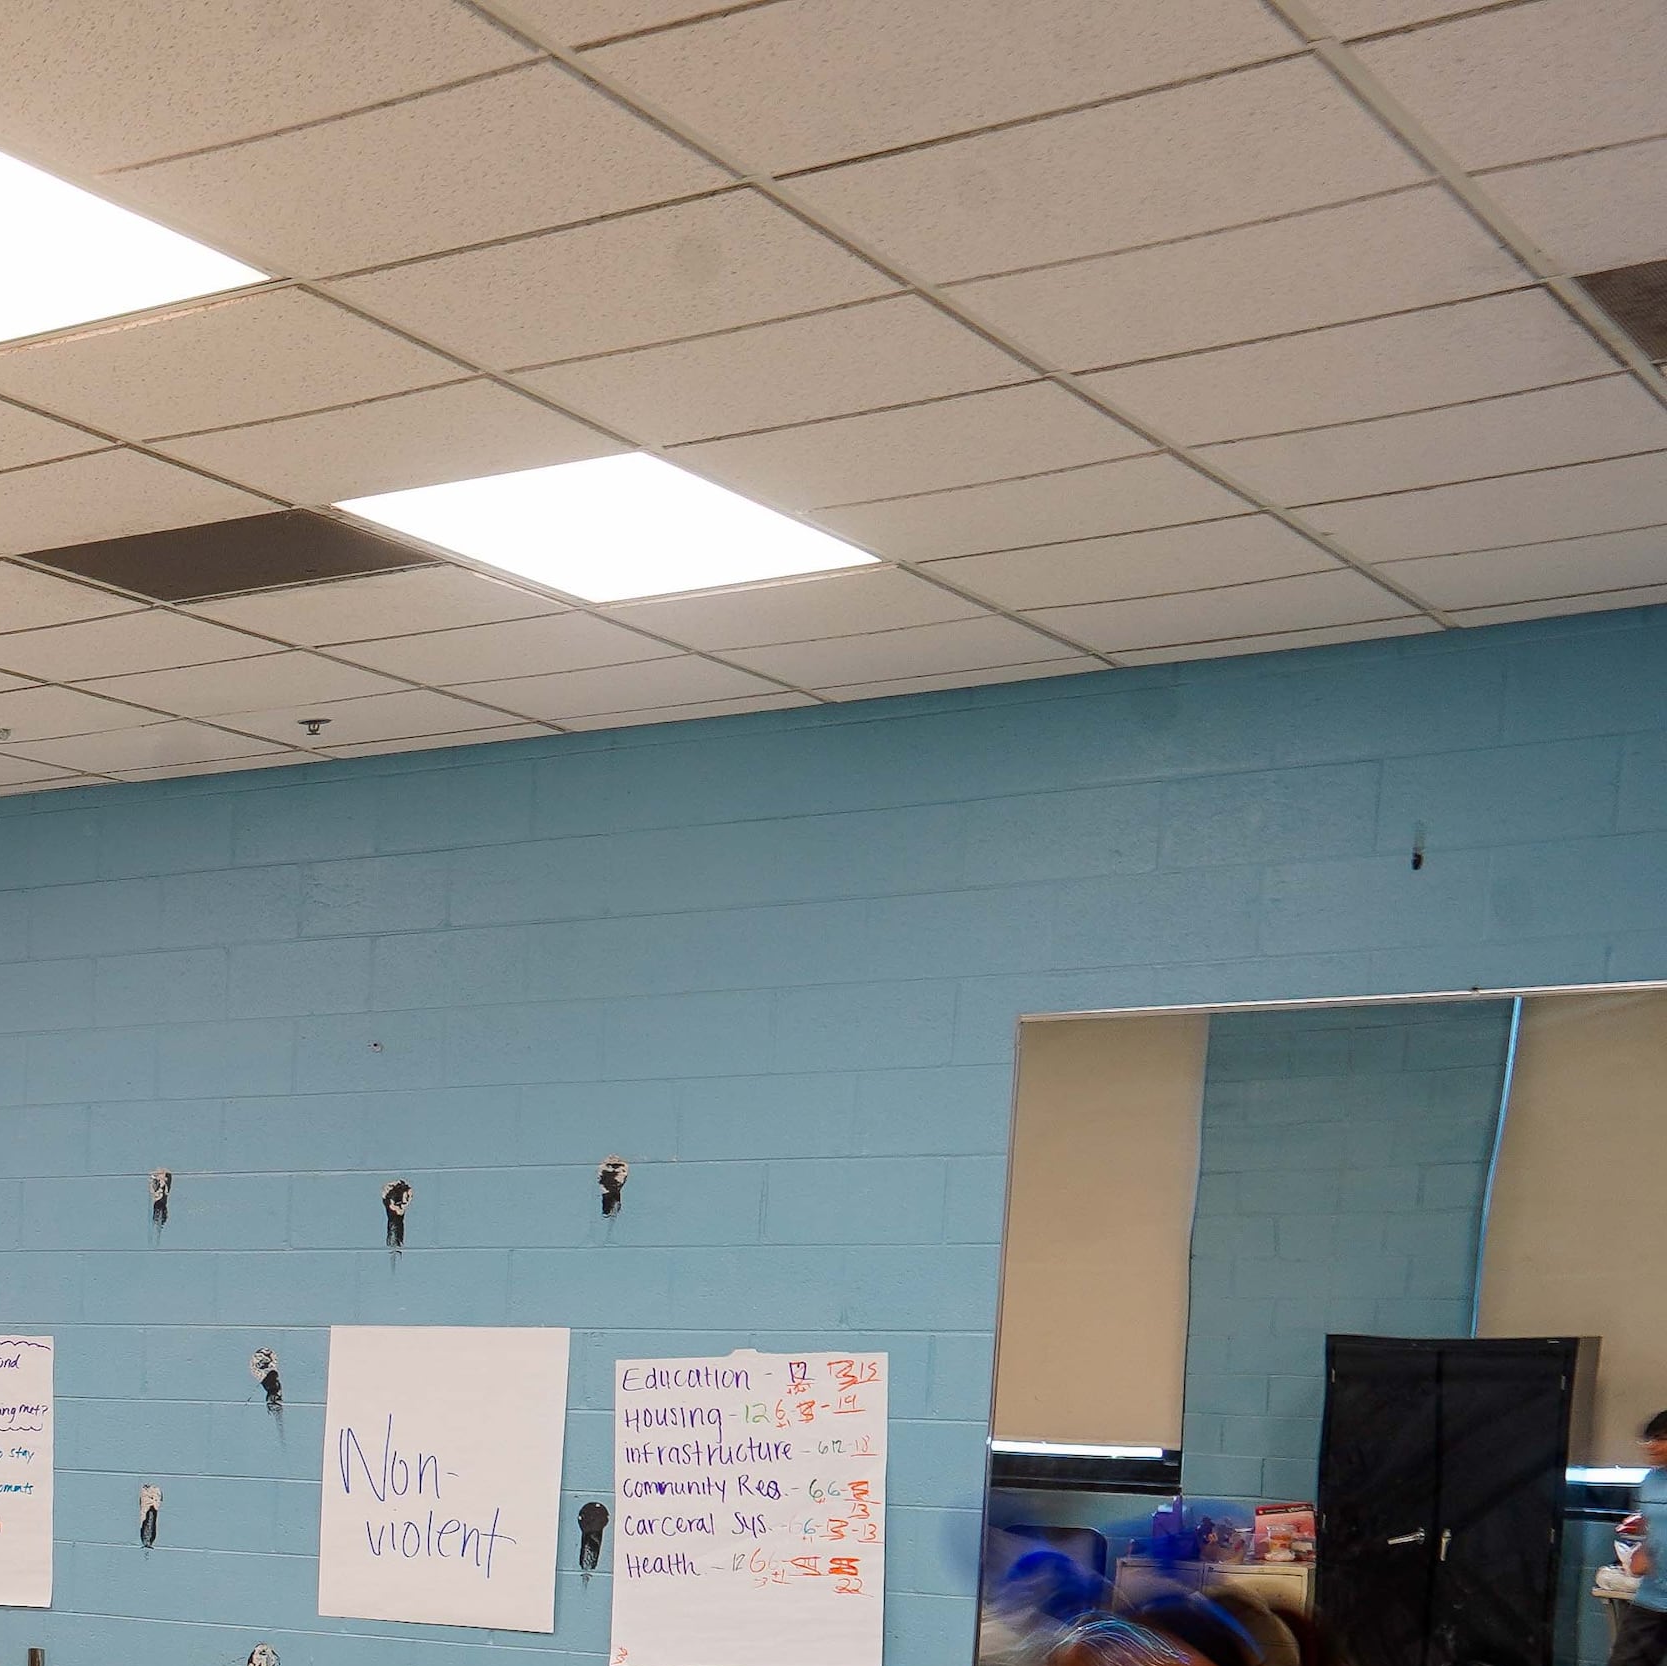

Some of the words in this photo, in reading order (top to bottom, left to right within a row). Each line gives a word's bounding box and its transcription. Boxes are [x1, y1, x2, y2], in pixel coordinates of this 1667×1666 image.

[621, 1360, 751, 1392] Education
[18, 1403, 49, 1417] met?
[624, 1404, 723, 1443] Housing
[743, 1402, 771, 1424] 12
[775, 1398, 787, 1421] 6
[8, 1446, 35, 1464] stay
[339, 1413, 460, 1502] Non-
[624, 1436, 793, 1467] infrastructure
[808, 1478, 824, 1499] 6
[827, 1480, 841, 1497] 6
[803, 1517, 817, 1536] 6
[366, 1507, 517, 1579] violent
[626, 1551, 701, 1579] Health
[732, 1552, 746, 1572] 12
[749, 1547, 766, 1574] 6
